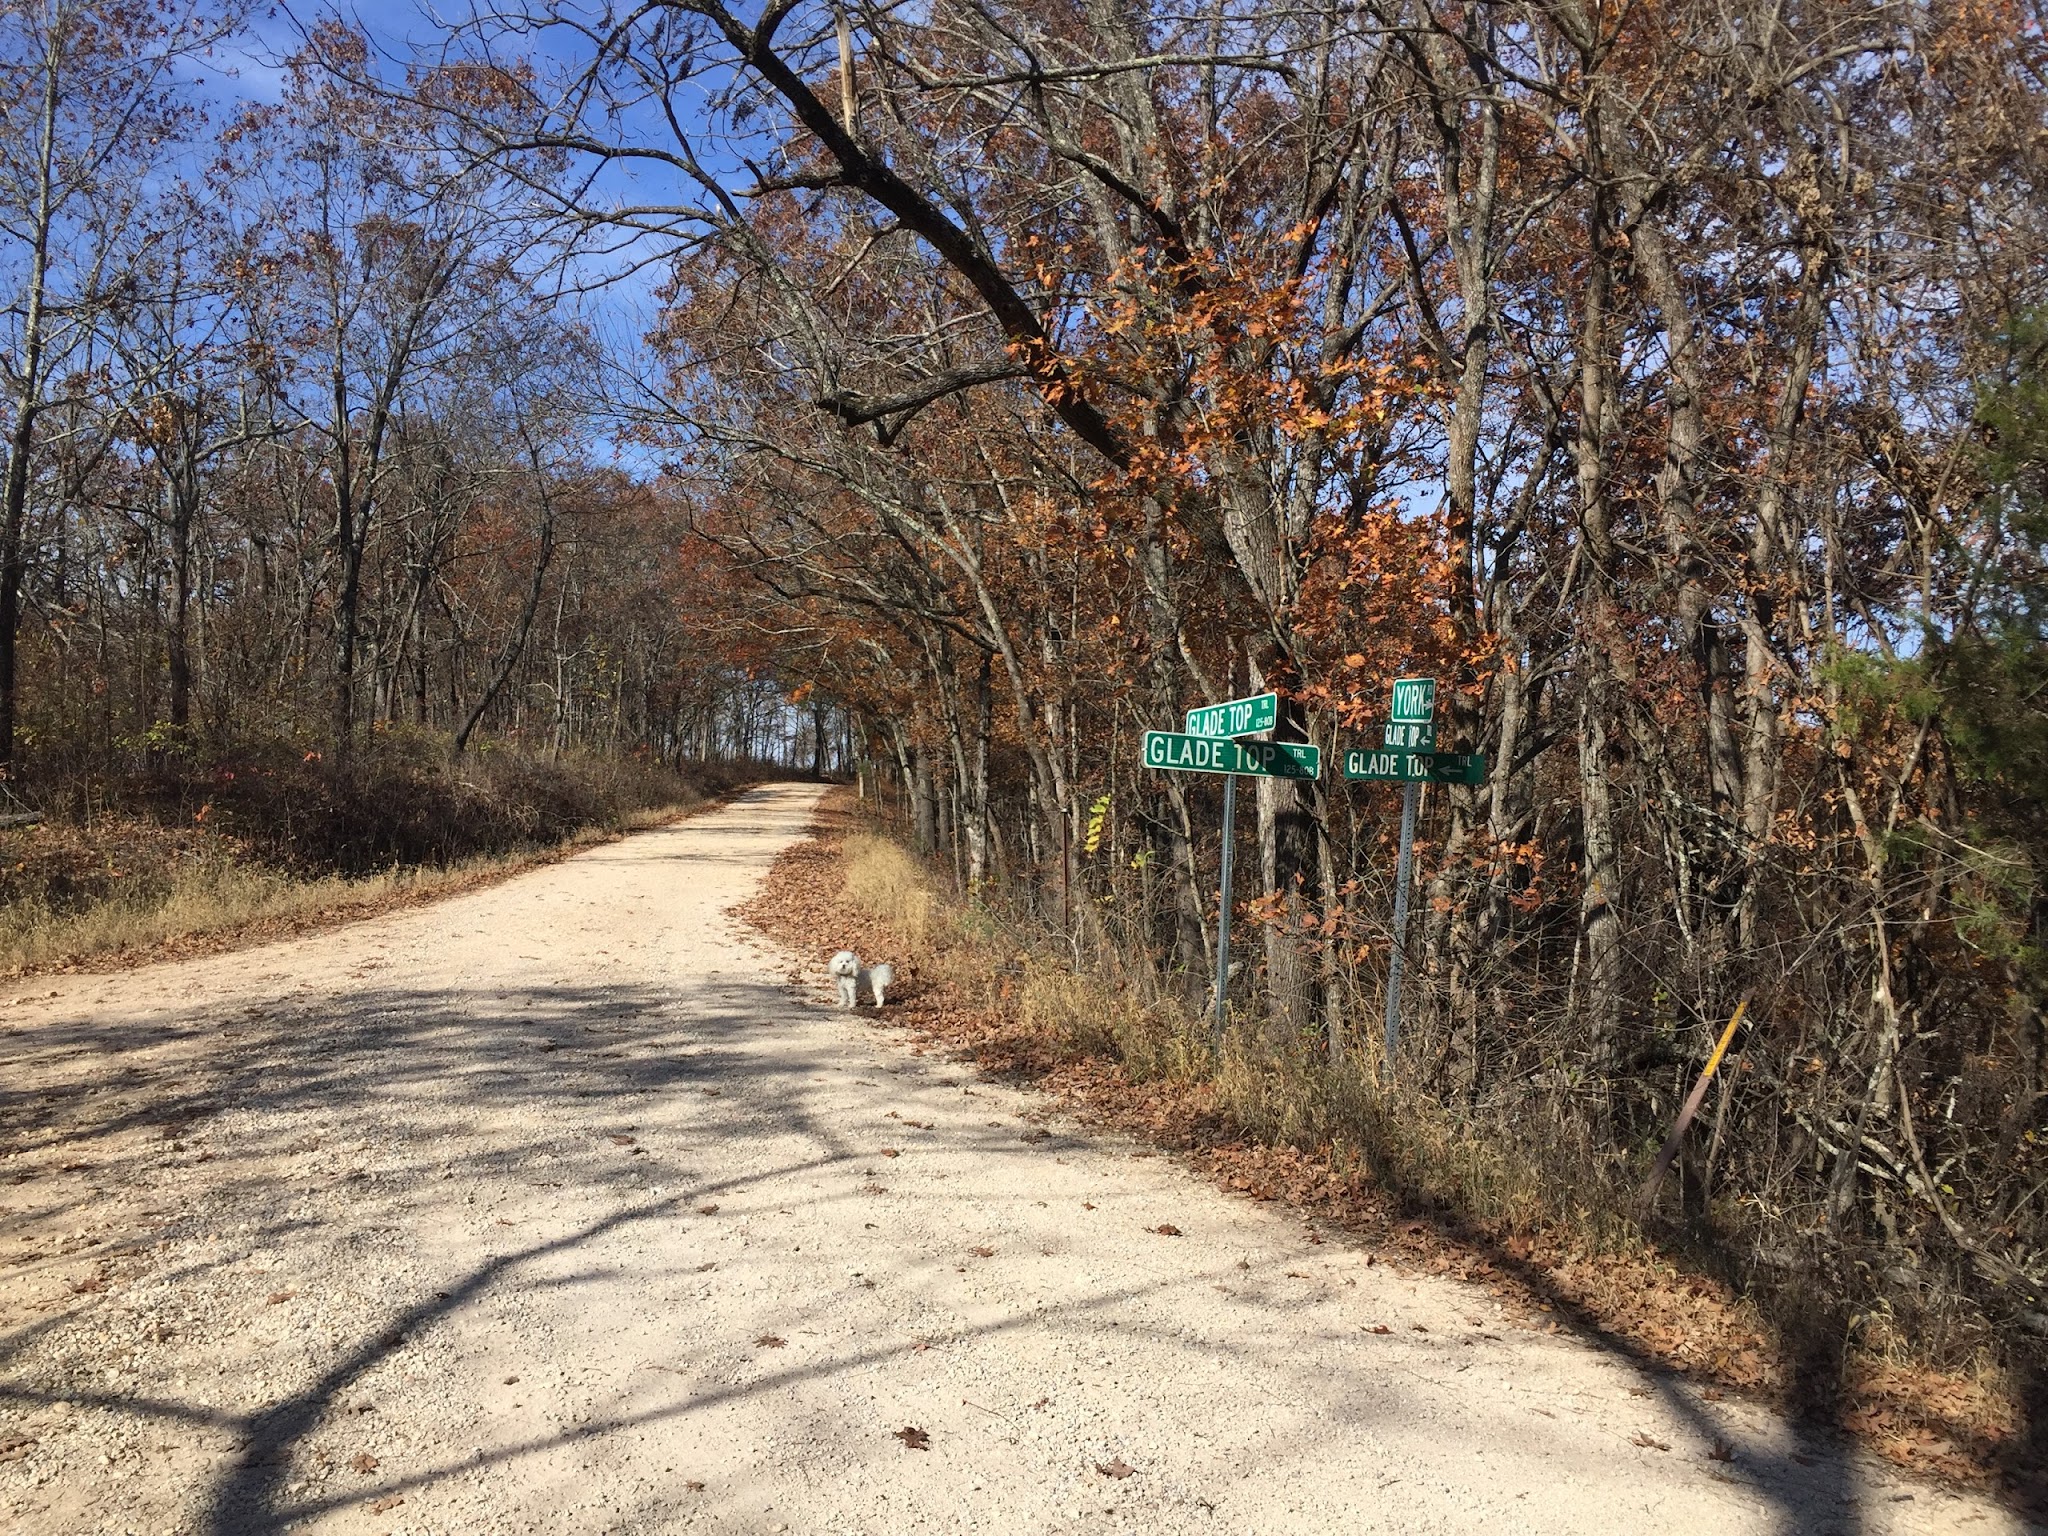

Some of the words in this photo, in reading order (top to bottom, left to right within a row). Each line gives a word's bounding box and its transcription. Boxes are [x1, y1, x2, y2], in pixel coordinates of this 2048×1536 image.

[1396, 684, 1426, 716] YORK
[1189, 708, 1225, 736] GLADE
[1229, 704, 1253, 733] TOP
[1385, 724, 1405, 746] GLADE
[1408, 725, 1420, 748] TOP
[1151, 736, 1224, 768] GLADE
[1234, 743, 1276, 772] TOP
[1293, 748, 1306, 759] TRL
[1349, 752, 1399, 776] GLADE
[1406, 754, 1434, 777] TOP
[1458, 755, 1472, 767] TRL
